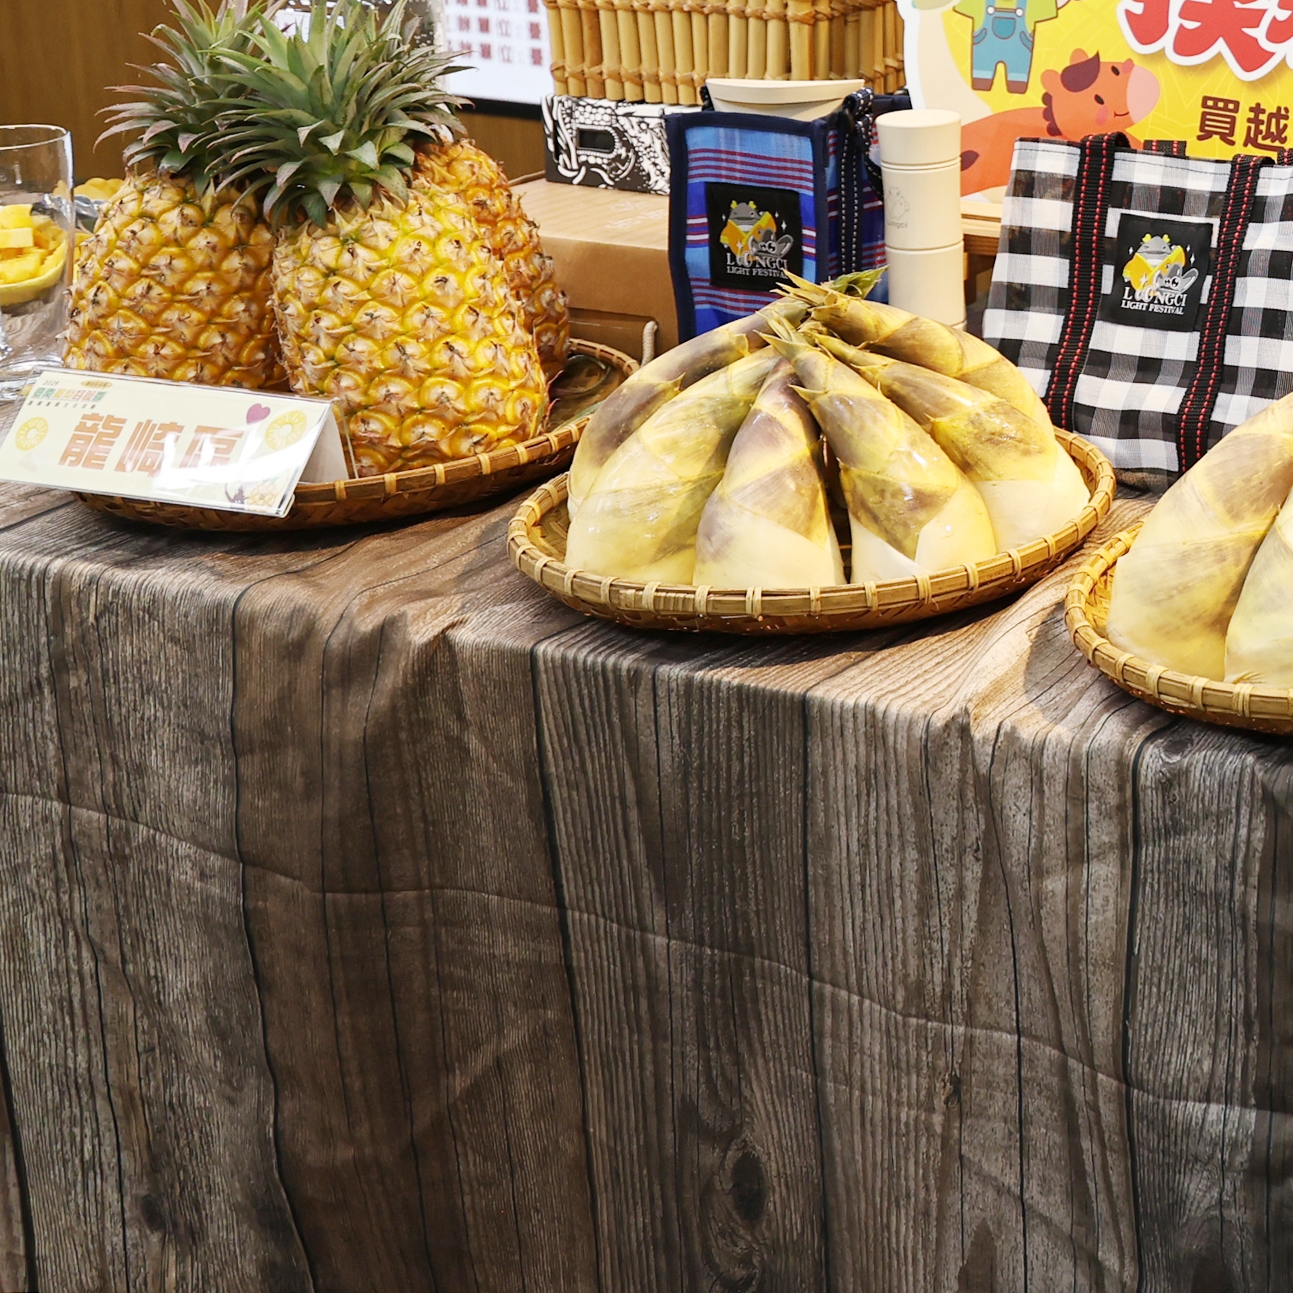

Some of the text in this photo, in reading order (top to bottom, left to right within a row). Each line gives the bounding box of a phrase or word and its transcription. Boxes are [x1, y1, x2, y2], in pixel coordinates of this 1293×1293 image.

[726, 265, 751, 276] LIGHT
[1120, 299, 1185, 316] LIGHT FESTIVAL
